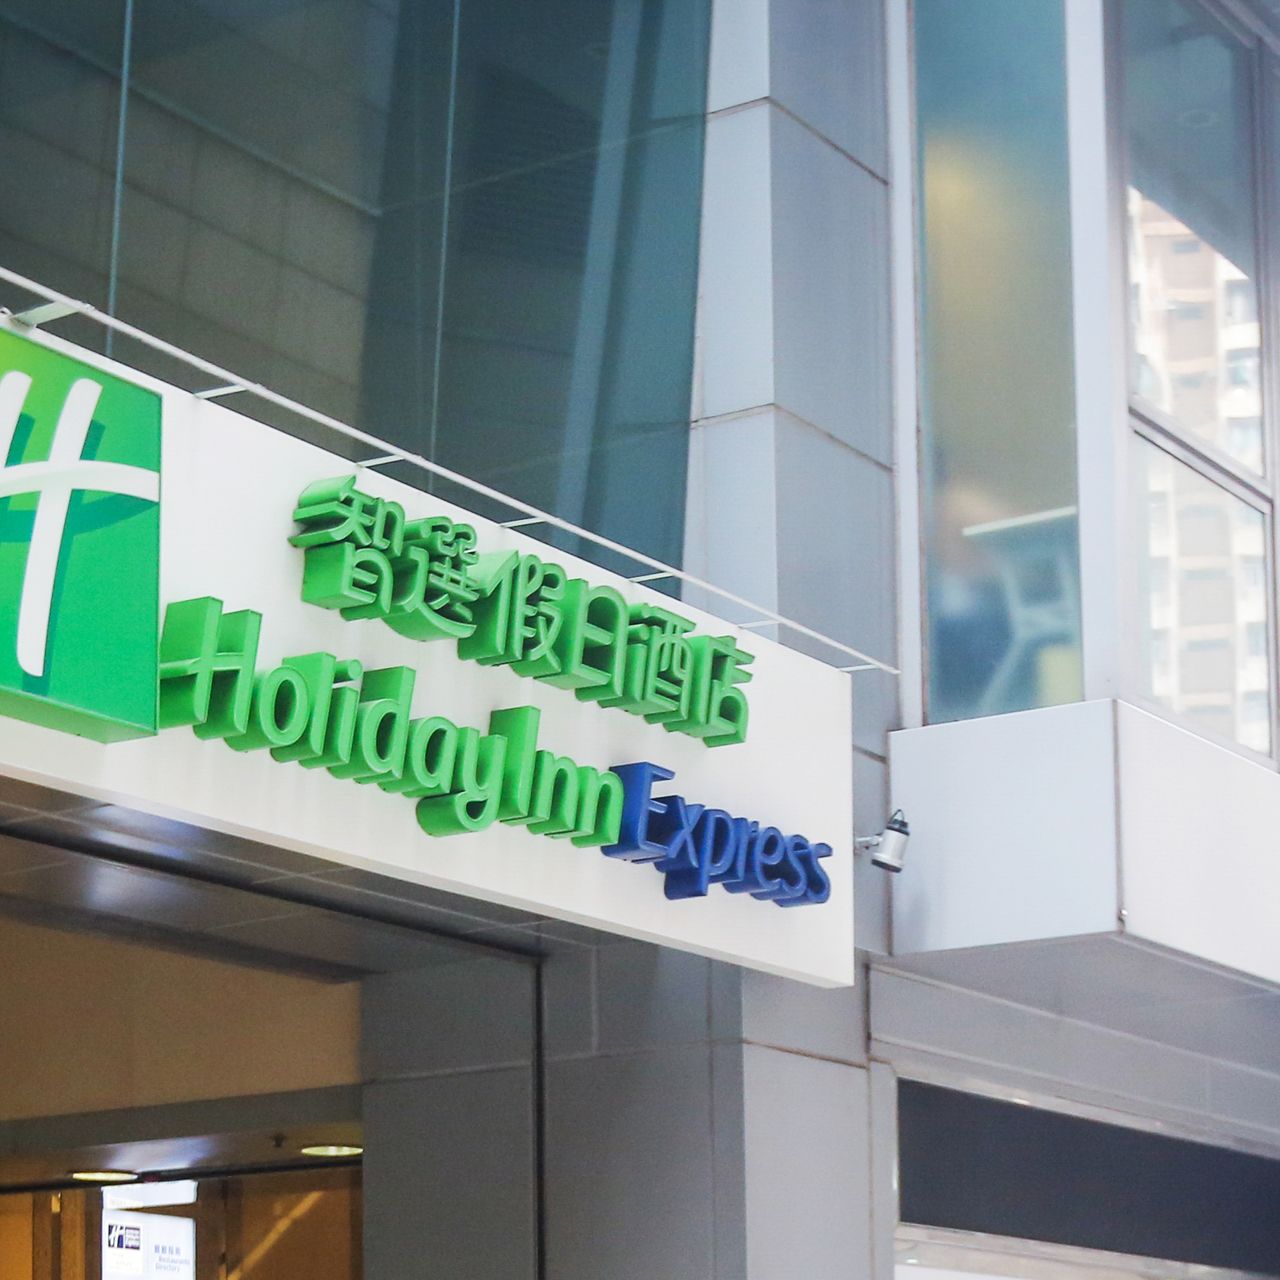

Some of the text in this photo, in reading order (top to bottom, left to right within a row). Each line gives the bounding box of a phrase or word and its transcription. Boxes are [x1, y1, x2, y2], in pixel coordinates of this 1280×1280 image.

[160, 596, 832, 908] Holiday Inn Express
[288, 474, 756, 747] 智選假日酒店
